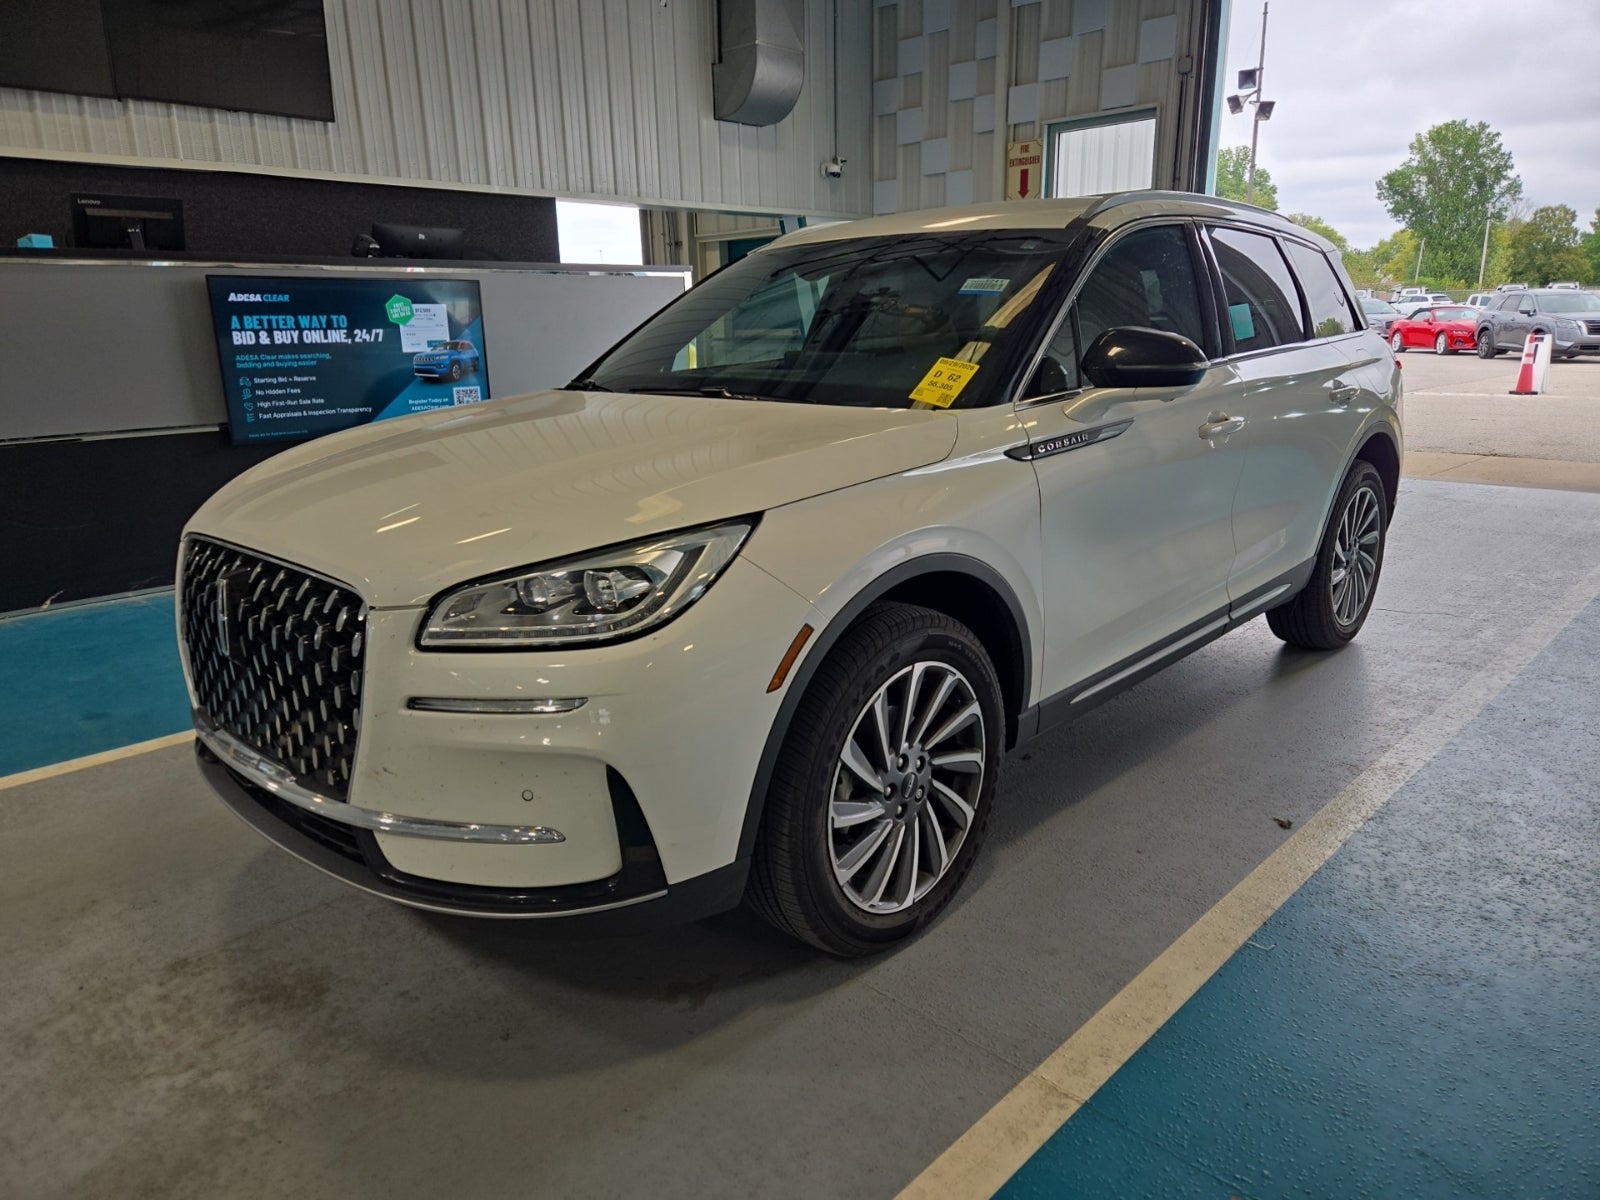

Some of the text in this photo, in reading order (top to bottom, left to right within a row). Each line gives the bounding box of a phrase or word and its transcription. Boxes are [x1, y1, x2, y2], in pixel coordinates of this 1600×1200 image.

[1020, 144, 1030, 153] FIRE
[1009, 155, 1040, 167] EXTINGUISHER
[228, 292, 290, 302] ADESA CLEAR
[231, 315, 348, 330] A BETTER WAY TO
[232, 329, 384, 345] BID & BUY ONLINE, 24/7
[276, 360, 298, 368] buying
[934, 370, 943, 378] D
[947, 373, 961, 383] 62
[273, 411, 302, 419] Appraisals
[1038, 433, 1089, 453] CORSAIR
